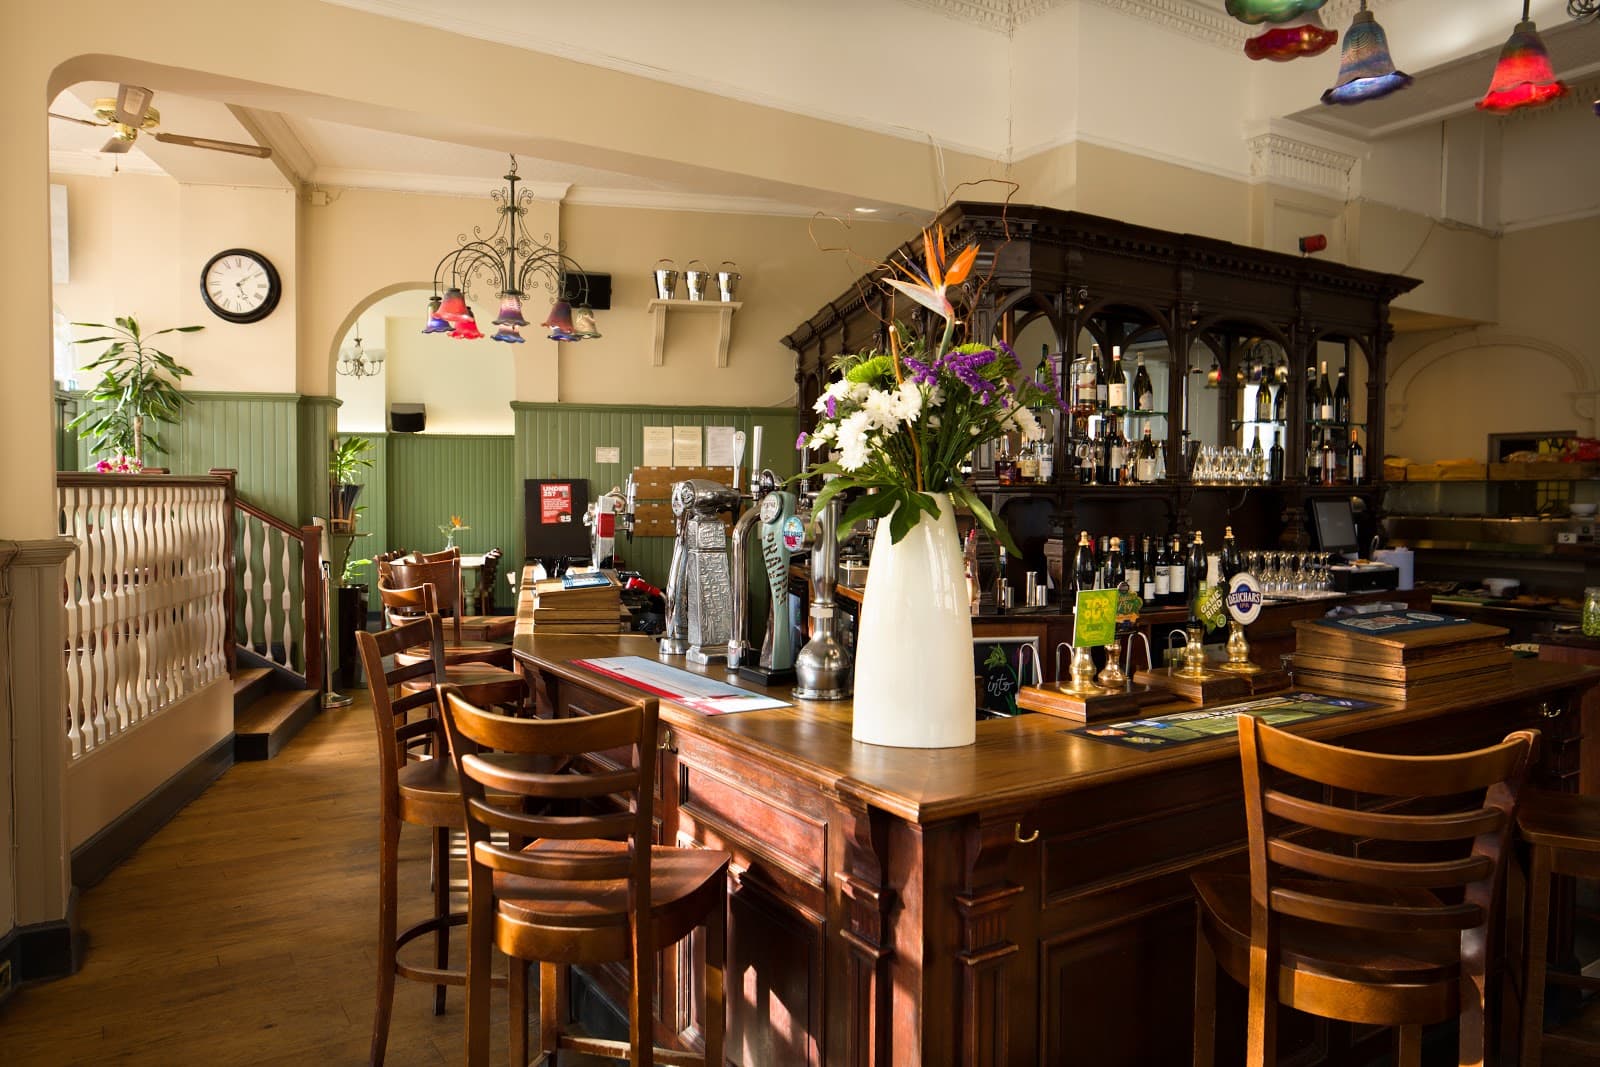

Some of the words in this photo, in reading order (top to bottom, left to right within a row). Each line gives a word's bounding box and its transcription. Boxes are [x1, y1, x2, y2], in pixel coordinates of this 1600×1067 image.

[1200, 590, 1221, 613] GAME
[1228, 592, 1260, 604] DEUCHARS
[1205, 600, 1223, 619] BIRD
[987, 673, 1015, 696] into
